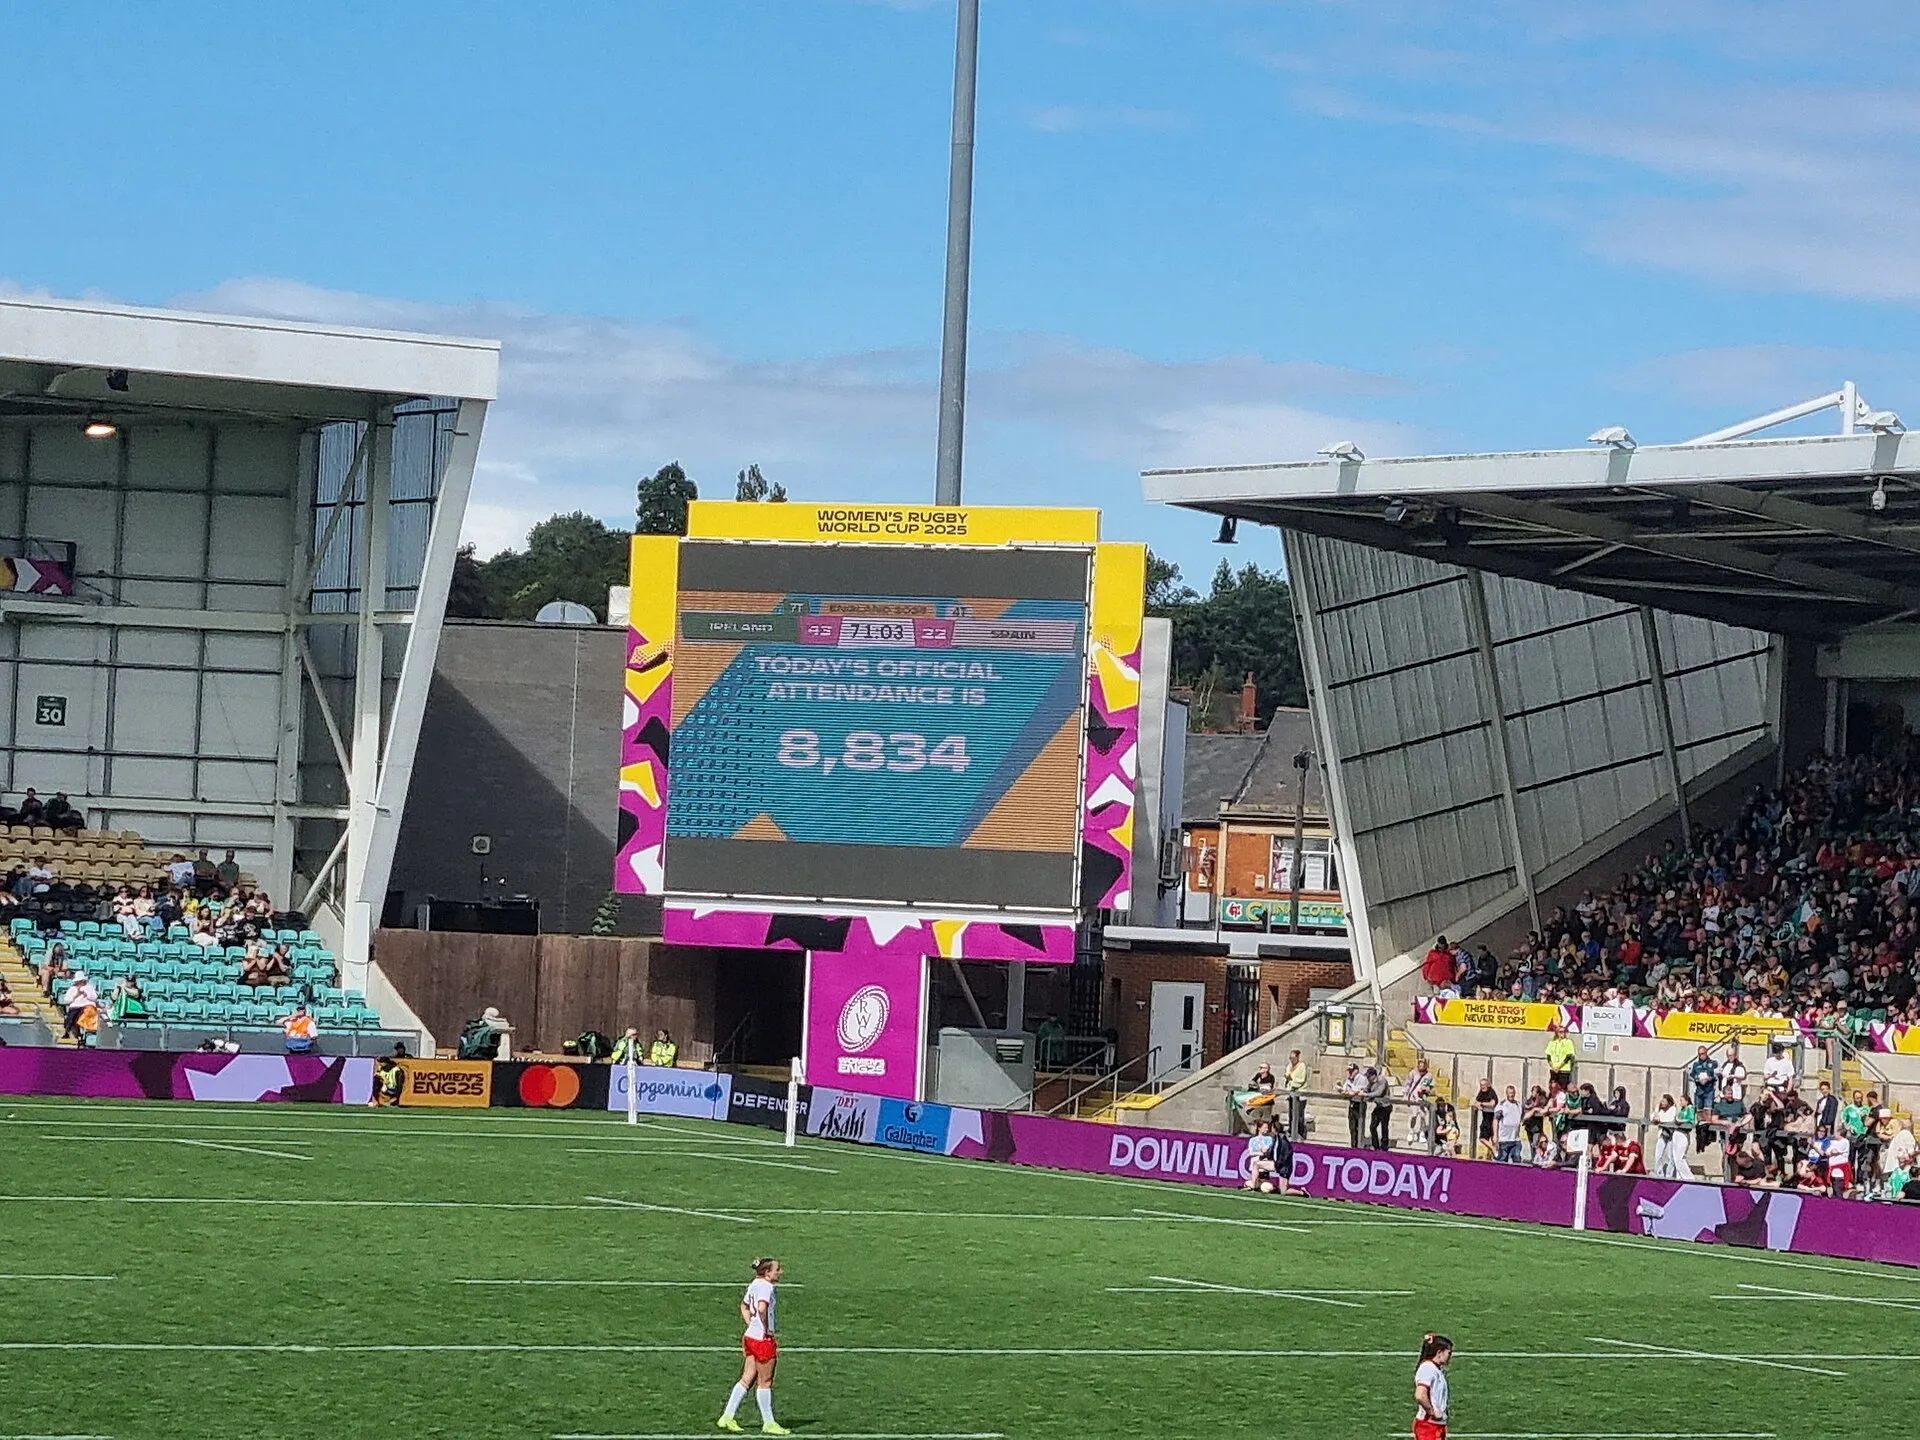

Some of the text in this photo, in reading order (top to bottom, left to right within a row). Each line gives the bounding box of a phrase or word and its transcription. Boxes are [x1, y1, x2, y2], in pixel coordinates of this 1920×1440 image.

[817, 510, 968, 523] WOMEN'S RUGBY
[817, 522, 968, 535] WORLD CUP 2025
[709, 622, 773, 633] IRELAND
[850, 623, 904, 640] 71:03
[921, 628, 947, 640] 22
[991, 629, 1036, 640] SPAIN
[755, 656, 1002, 679] TODAY'S OFFICIAL
[766, 682, 985, 705] ATTENDANCE IS
[39, 708, 61, 722] 30
[776, 728, 971, 775] 8,834
[1465, 1003, 1526, 1016] THIS ENERGY
[1465, 1013, 1526, 1025] NEVER STOPS
[413, 1071, 484, 1082] WOMEN'S
[413, 1081, 484, 1095] ENG25
[617, 1075, 703, 1102] Cpgemini
[818, 1103, 866, 1138] Asahi
[884, 1125, 938, 1149] Gallagher
[1108, 1134, 1452, 1203] DOWNLD TODAY!
